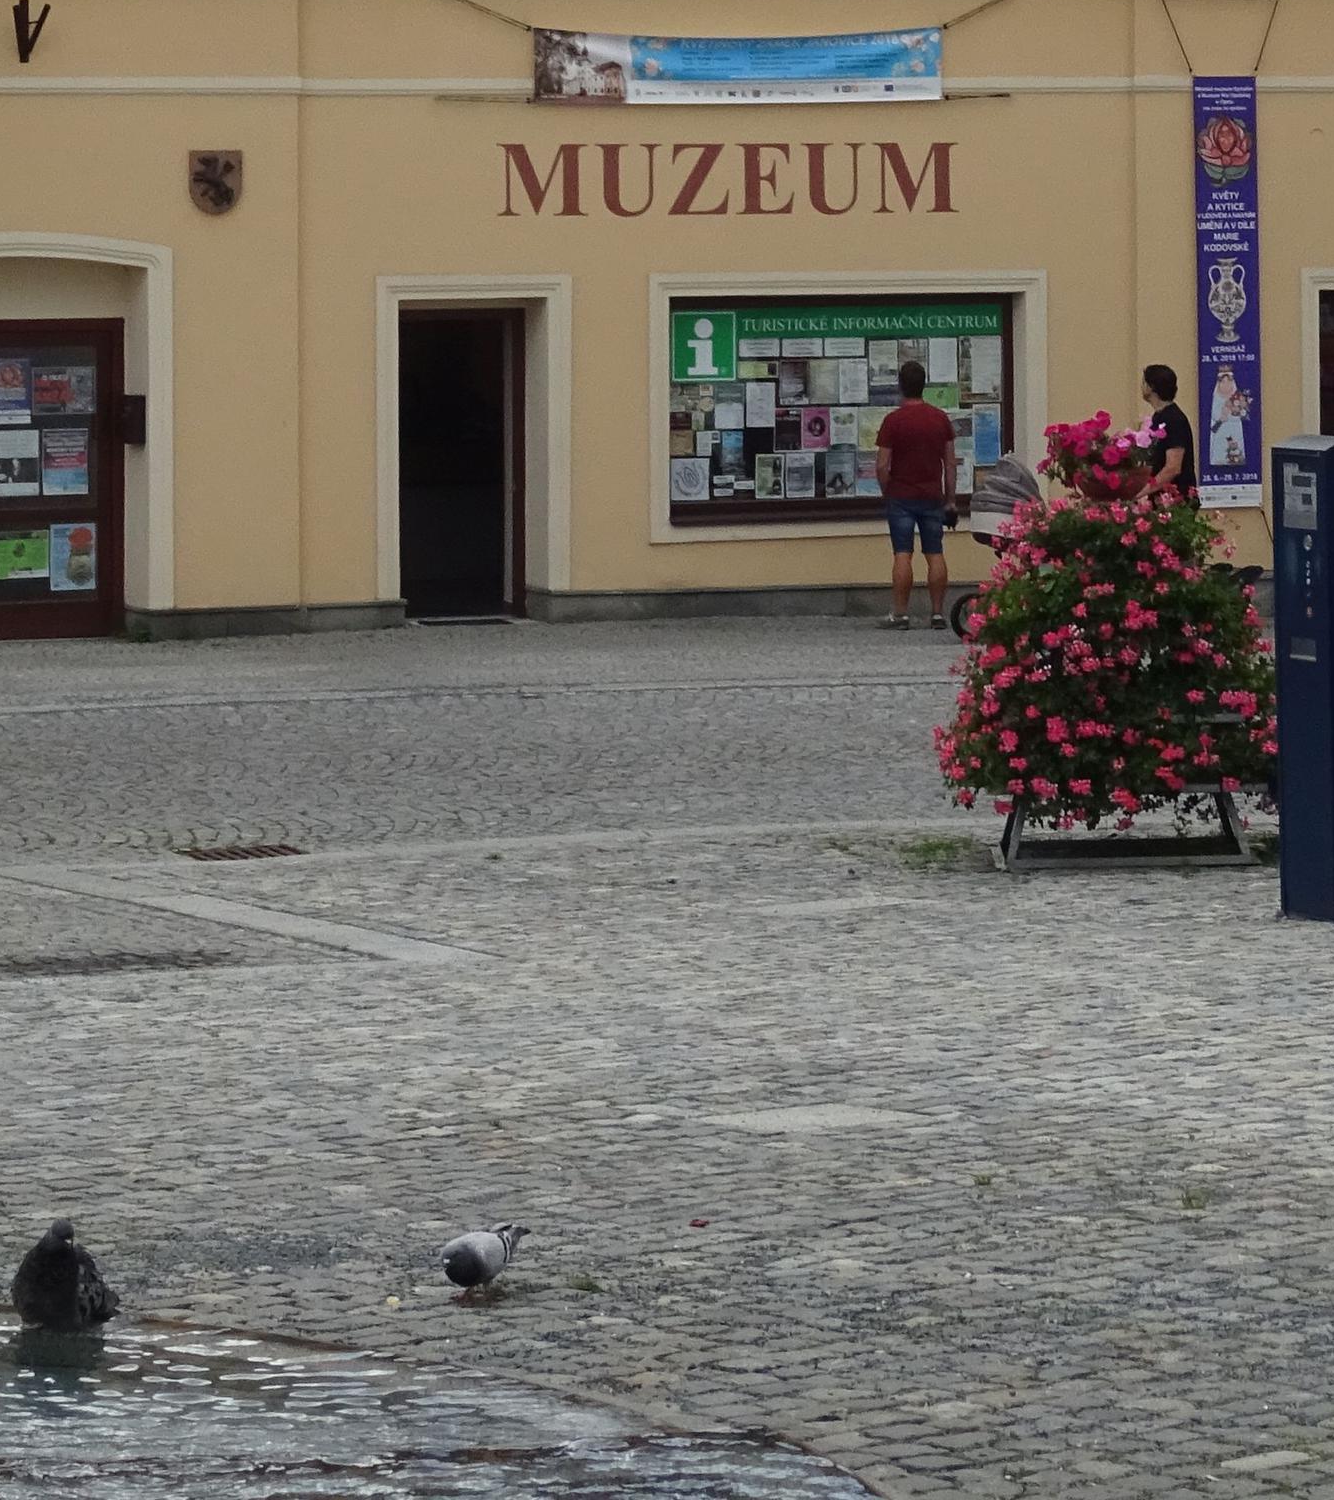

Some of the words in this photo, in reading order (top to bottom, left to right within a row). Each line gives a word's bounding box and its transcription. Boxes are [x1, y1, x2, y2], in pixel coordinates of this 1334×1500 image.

[496, 142, 960, 218] MUZEUM
[1211, 190, 1240, 200] KVĚTY
[1207, 203, 1214, 211] A
[1215, 202, 1245, 211] KYTICE
[1213, 232, 1240, 241] MARIE
[1203, 241, 1249, 252] KODOVSKÉ
[742, 316, 829, 332] TURISTICKÉ
[833, 313, 925, 330] INFORMAČNÍ
[927, 314, 999, 330] CENTRUM
